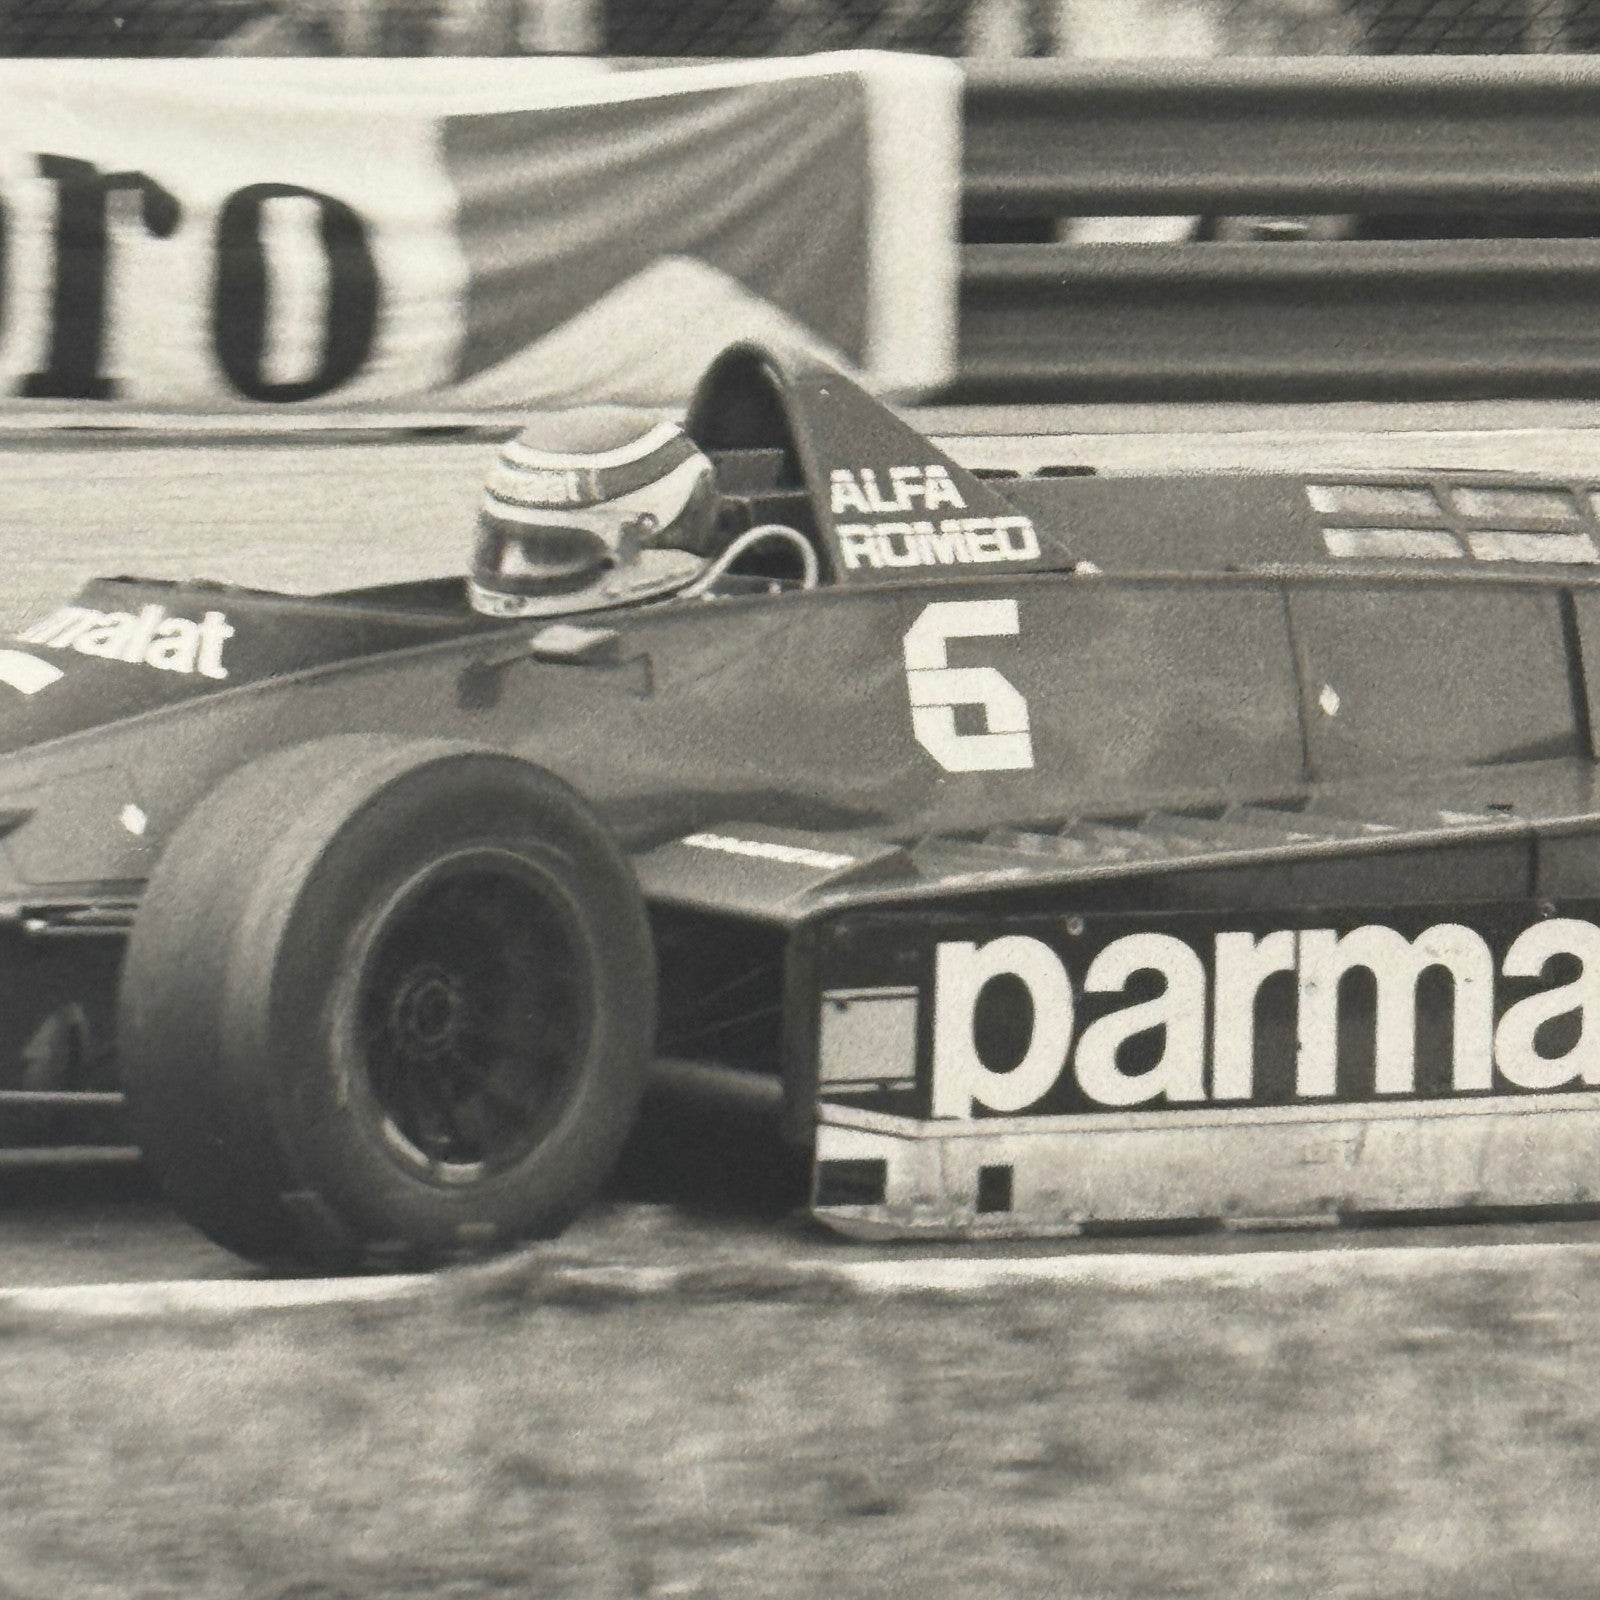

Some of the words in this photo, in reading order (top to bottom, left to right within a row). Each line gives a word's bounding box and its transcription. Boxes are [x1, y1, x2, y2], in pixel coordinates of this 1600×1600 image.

[0, 153, 380, 403] ro
[829, 464, 967, 514] ALFA
[836, 516, 1041, 570] ROMEO
[903, 598, 1035, 772] 6
[930, 917, 1600, 1120] parma
